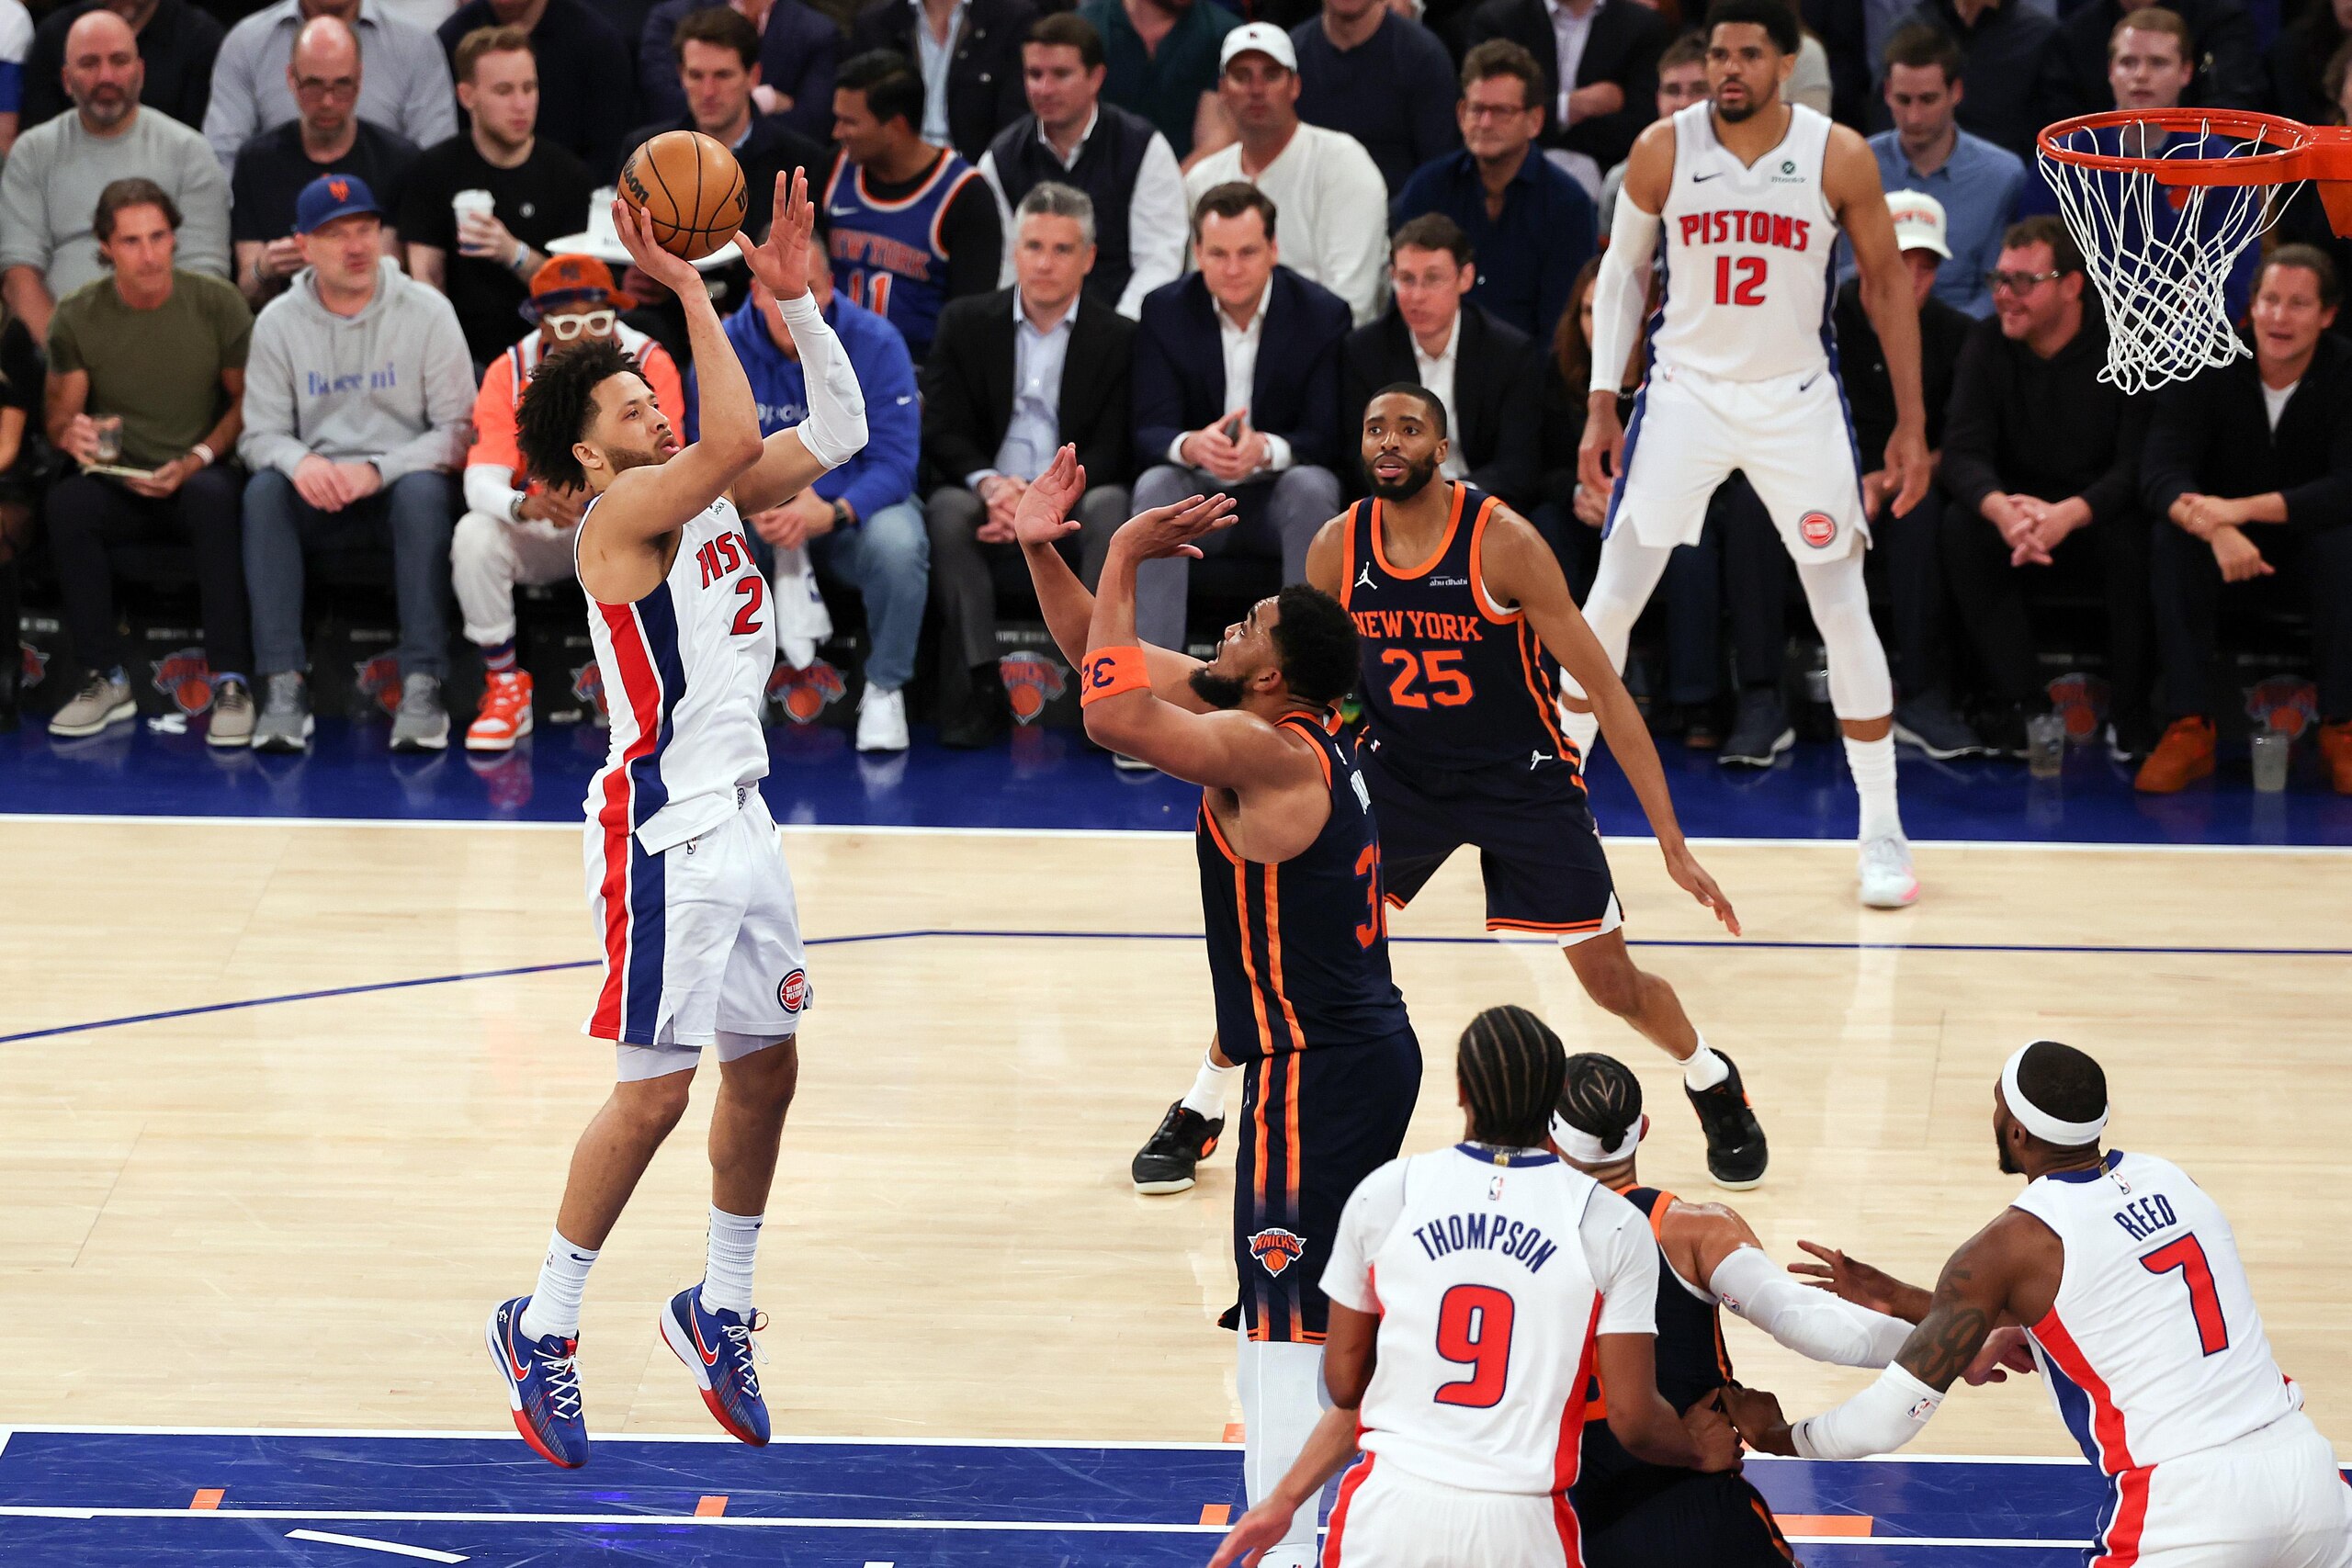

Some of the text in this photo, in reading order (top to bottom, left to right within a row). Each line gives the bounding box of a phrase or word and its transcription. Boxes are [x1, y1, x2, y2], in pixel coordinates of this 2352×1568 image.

[1679, 209, 1811, 253] PISTONS
[847, 268, 893, 318] 11
[1714, 255, 1767, 307] 12
[729, 575, 763, 636] 2
[1351, 610, 1483, 642] NEW YORK
[1380, 647, 1474, 710] 25
[1412, 1213, 1558, 1274] THOMPSON
[2113, 1193, 2177, 1242] REED
[1251, 1235, 1301, 1255] KNICKS
[2139, 1231, 2229, 1358] 7
[1433, 1283, 1515, 1409] 9
